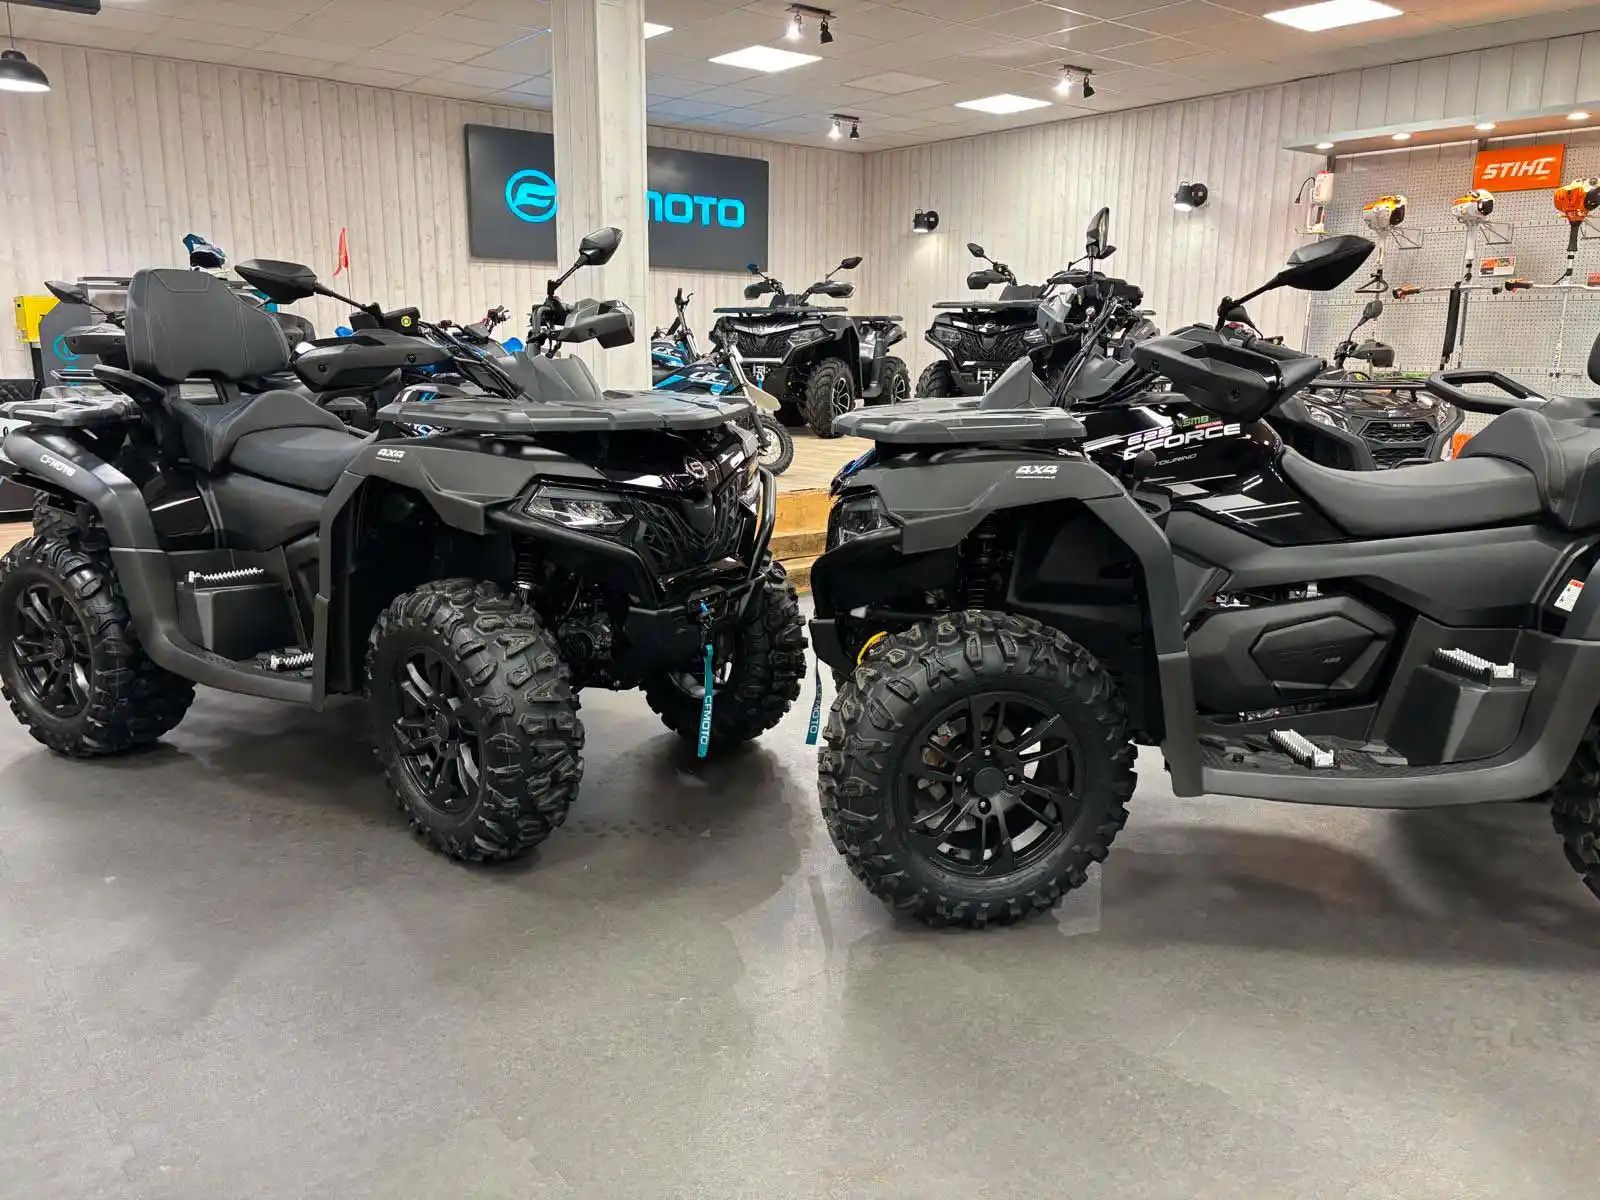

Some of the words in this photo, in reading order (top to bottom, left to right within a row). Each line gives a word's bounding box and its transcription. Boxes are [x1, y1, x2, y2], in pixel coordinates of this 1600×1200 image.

[1481, 157, 1556, 180] STIHL
[1123, 423, 1241, 461] CFORCE
[1127, 427, 1173, 446] 625
[700, 695, 713, 746] CFMOTO
